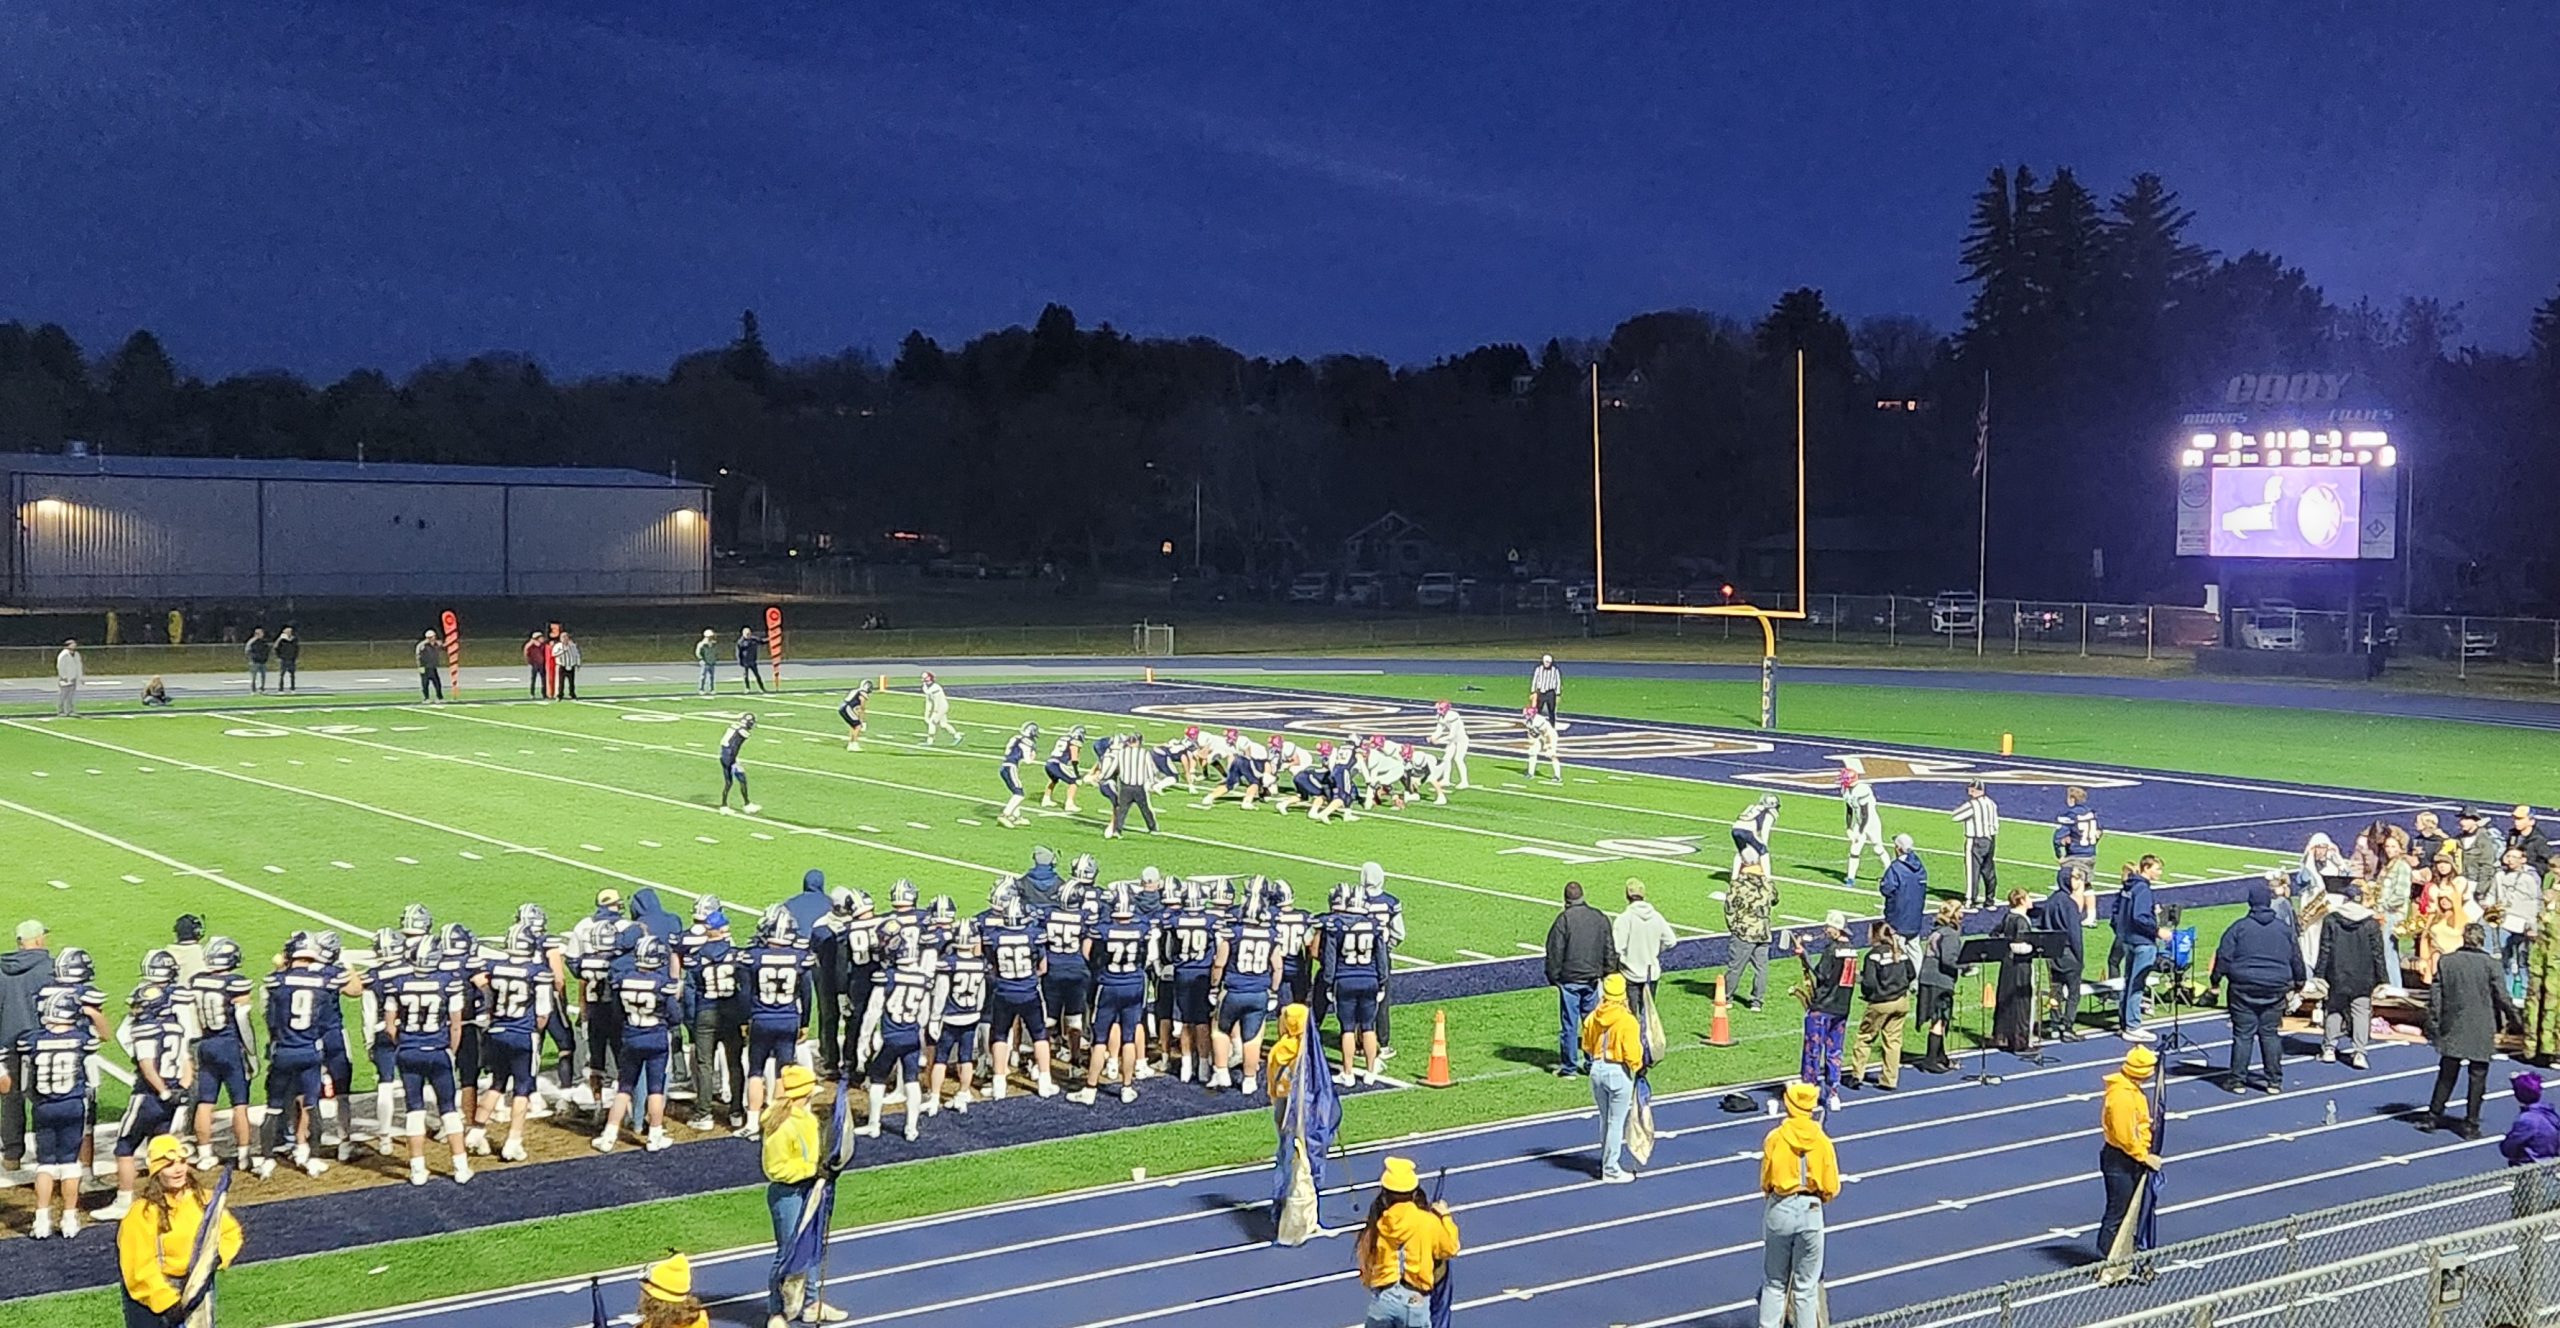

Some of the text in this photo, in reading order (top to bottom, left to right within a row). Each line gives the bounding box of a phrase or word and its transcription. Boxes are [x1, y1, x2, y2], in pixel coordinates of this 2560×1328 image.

[2225, 373, 2351, 402] CODY
[1046, 922, 1081, 954] 55
[1175, 929, 1208, 962] 79
[1342, 933, 1375, 965] 49
[1106, 941, 1139, 973] 71
[758, 967, 797, 1005] 63
[289, 989, 314, 1031] 9
[399, 994, 443, 1034] 77
[886, 985, 926, 1024] 45
